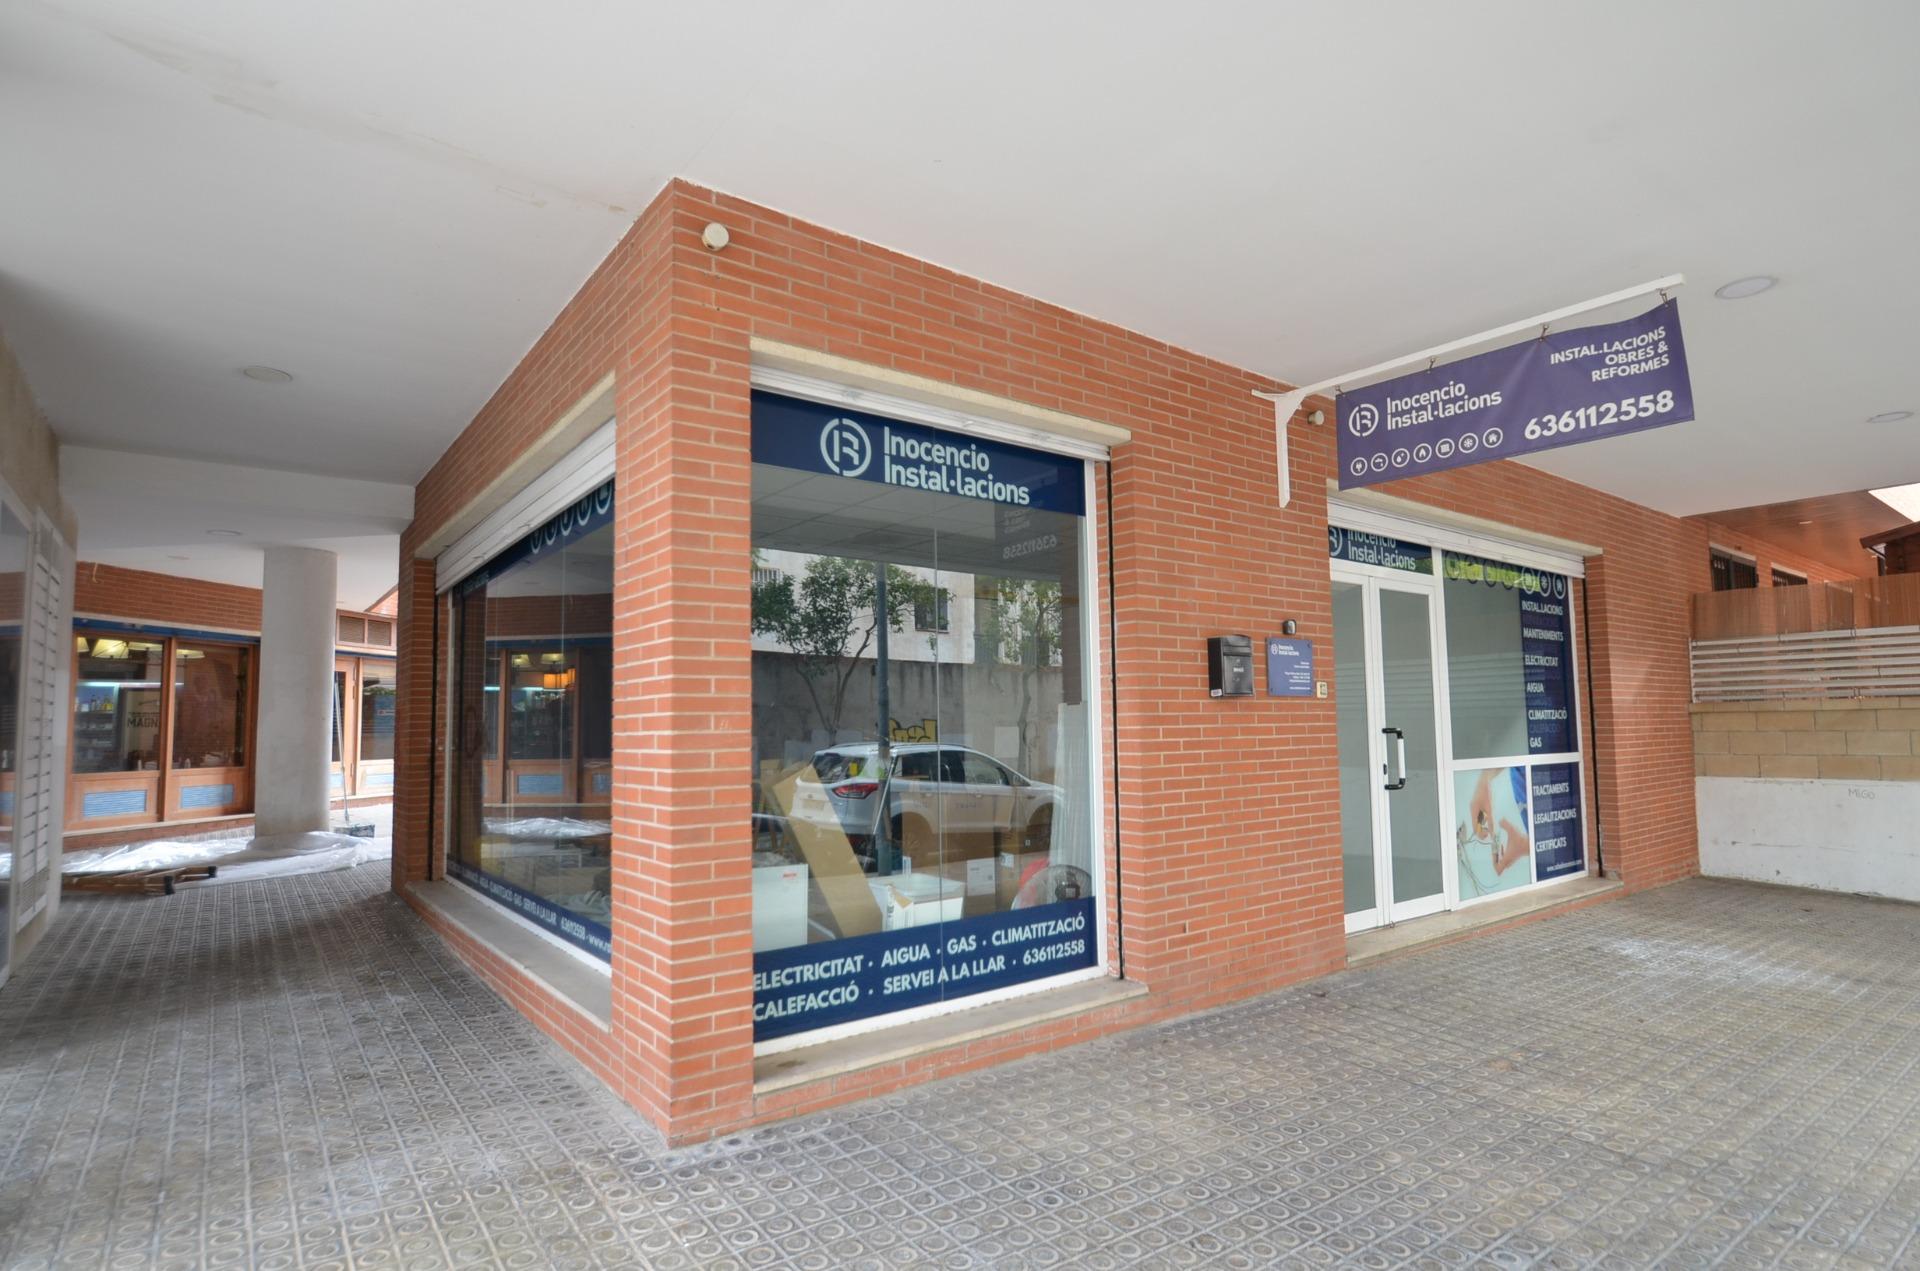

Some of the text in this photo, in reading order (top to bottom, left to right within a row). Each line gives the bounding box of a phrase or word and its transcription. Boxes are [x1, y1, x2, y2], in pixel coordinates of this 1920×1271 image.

[1550, 326, 1666, 365] INSTAL.LACIONS
[1605, 341, 1669, 366] OBRES &
[1591, 354, 1670, 382] REFORMES
[1387, 380, 1466, 414] Inocencio
[1387, 391, 1502, 431] Instal·lacions
[1524, 390, 1675, 440] 636112558
[884, 426, 990, 472] Inocencio
[884, 455, 1030, 506] Instal·lacions
[1348, 541, 1416, 570] Instal·lacions
[1525, 654, 1558, 667] ELECTRICITAT
[1526, 682, 1545, 693] AIGUA
[1530, 736, 1542, 748] GAS
[1533, 782, 1569, 797] TRACTAMENTS
[1534, 808, 1576, 824] LEGALITZACIONS
[1535, 837, 1567, 853] CERTIFICATS
[752, 911, 1085, 991] ELECTRICITAT AIGUA GAS CLIMATITZACIÓ
[752, 979, 860, 1021] CALEFACCIÓ
[883, 969, 935, 995] SERVEI
[951, 962, 970, 981] LA
[972, 954, 1006, 977] LLAR
[1023, 939, 1085, 965] 636112558
